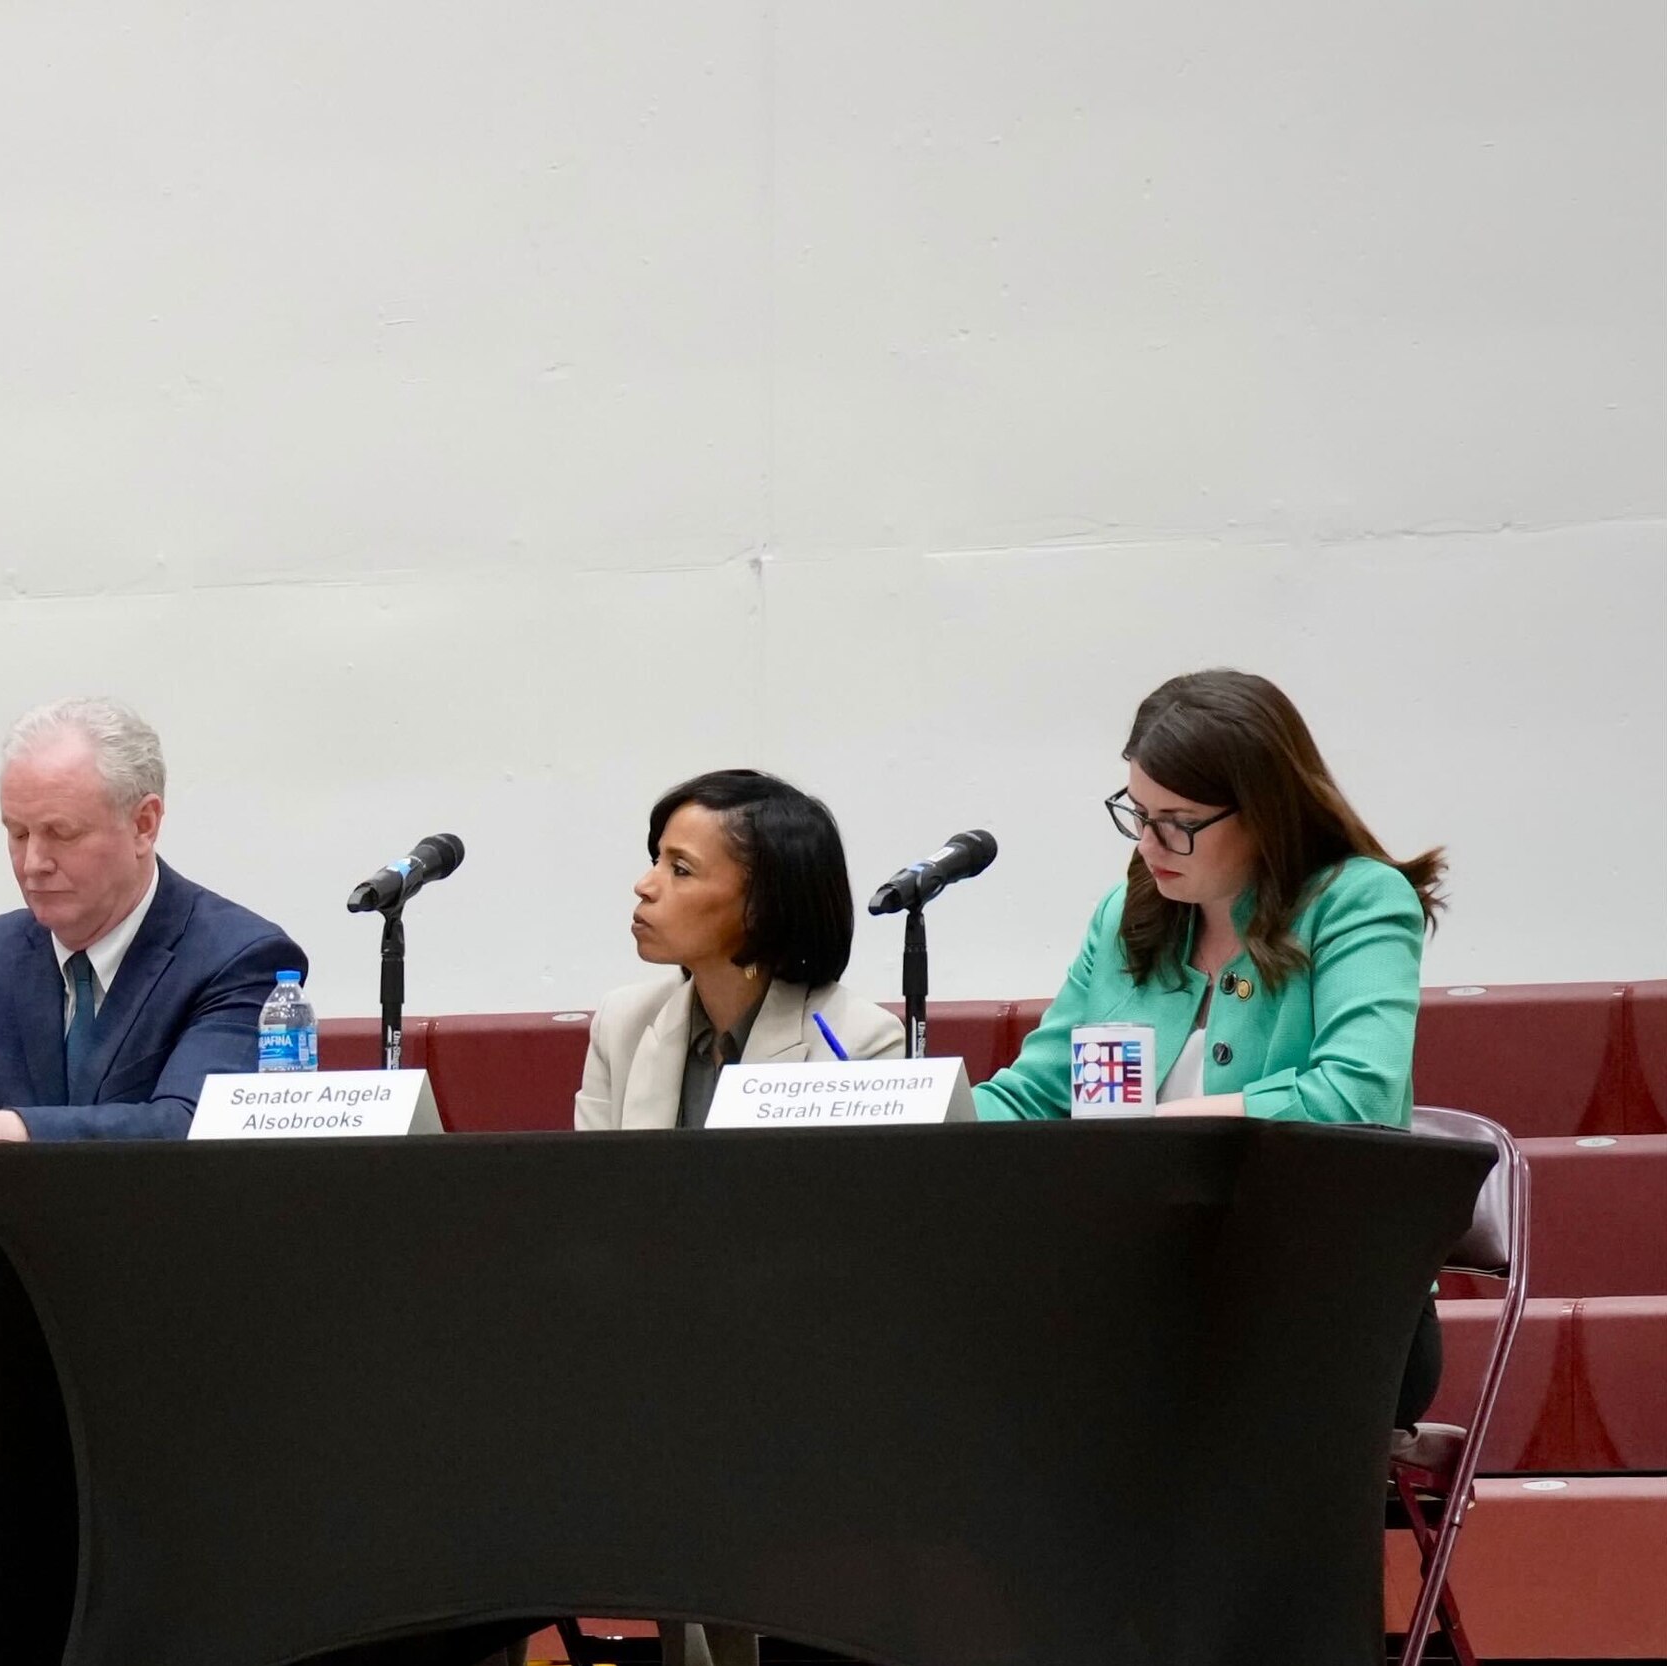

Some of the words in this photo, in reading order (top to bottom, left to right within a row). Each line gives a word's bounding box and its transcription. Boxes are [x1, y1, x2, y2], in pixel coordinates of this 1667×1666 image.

[1073, 1041, 1141, 1062] VOTE
[1073, 1061, 1142, 1083] VOTE
[230, 1088, 312, 1105] Senator
[317, 1085, 392, 1106] Angela
[742, 1076, 933, 1097] Congresswoman
[756, 1102, 821, 1119] Sarah
[830, 1100, 904, 1117] Elfreth
[242, 1112, 363, 1130] Alsobrooks
